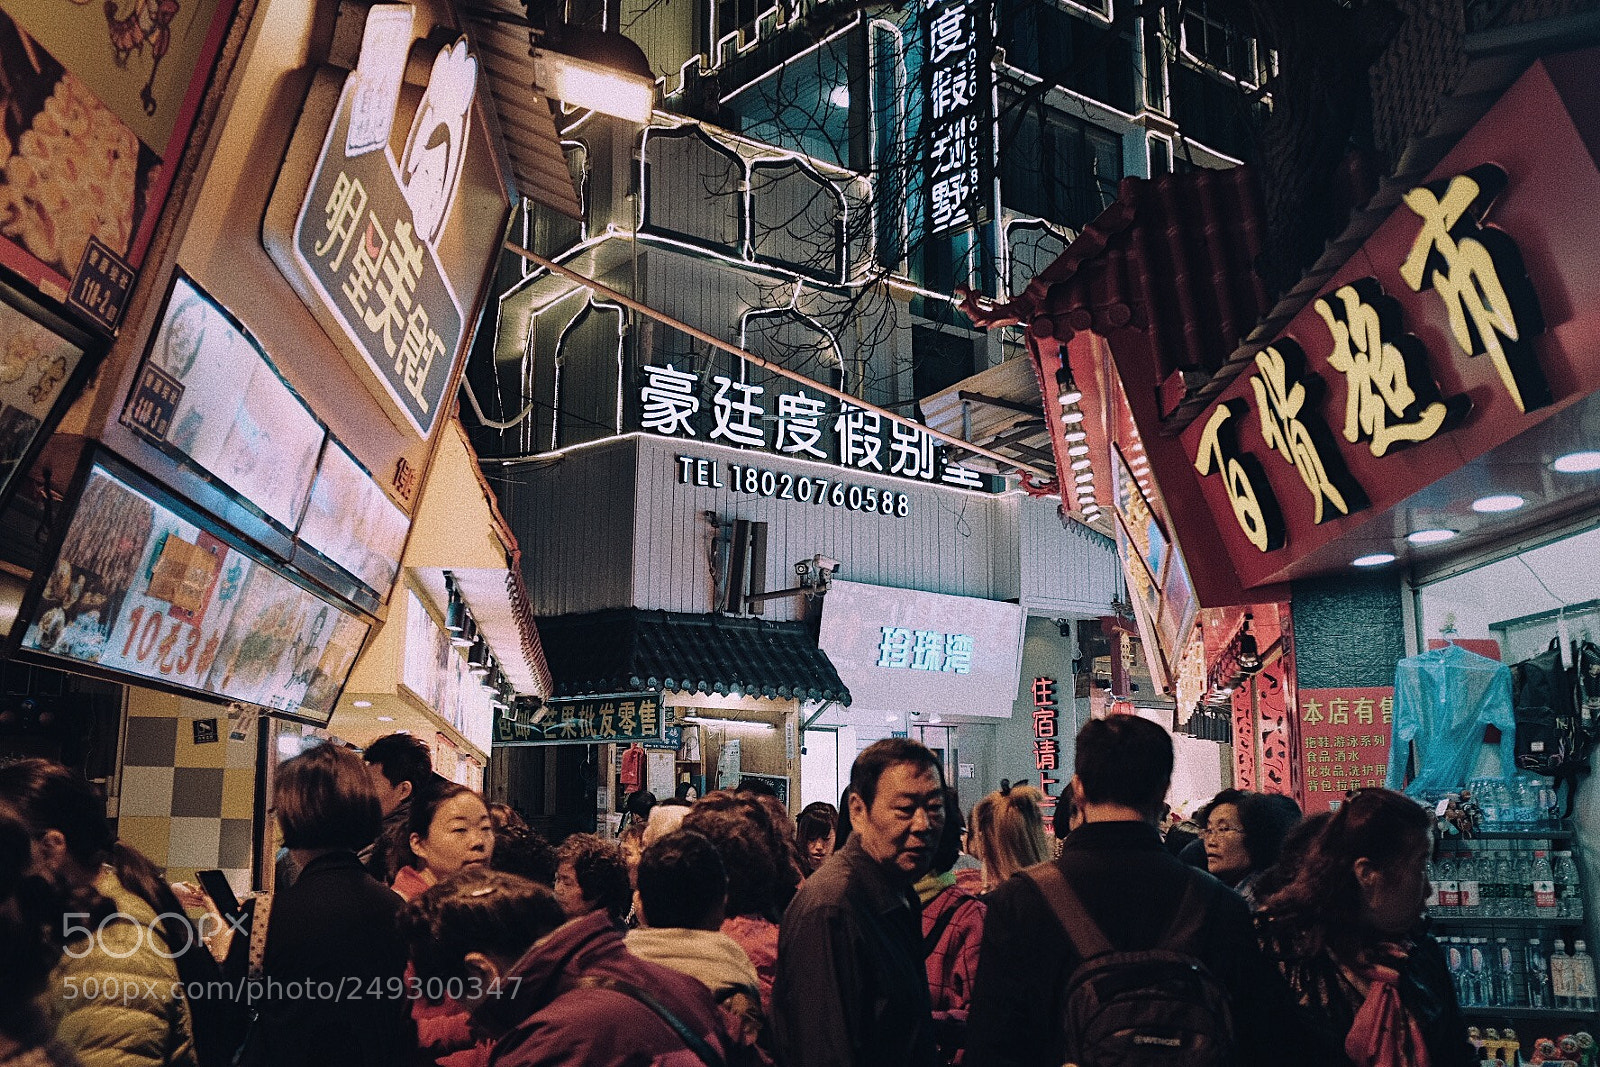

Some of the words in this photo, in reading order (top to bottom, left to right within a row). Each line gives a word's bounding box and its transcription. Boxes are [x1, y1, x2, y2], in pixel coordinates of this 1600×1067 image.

[928, 0, 973, 233] 度假别墅
[679, 457, 723, 487] TEL
[732, 465, 909, 517] 18020760588
[877, 627, 973, 674] 珍珠湾
[1303, 697, 1392, 725] 本店有售
